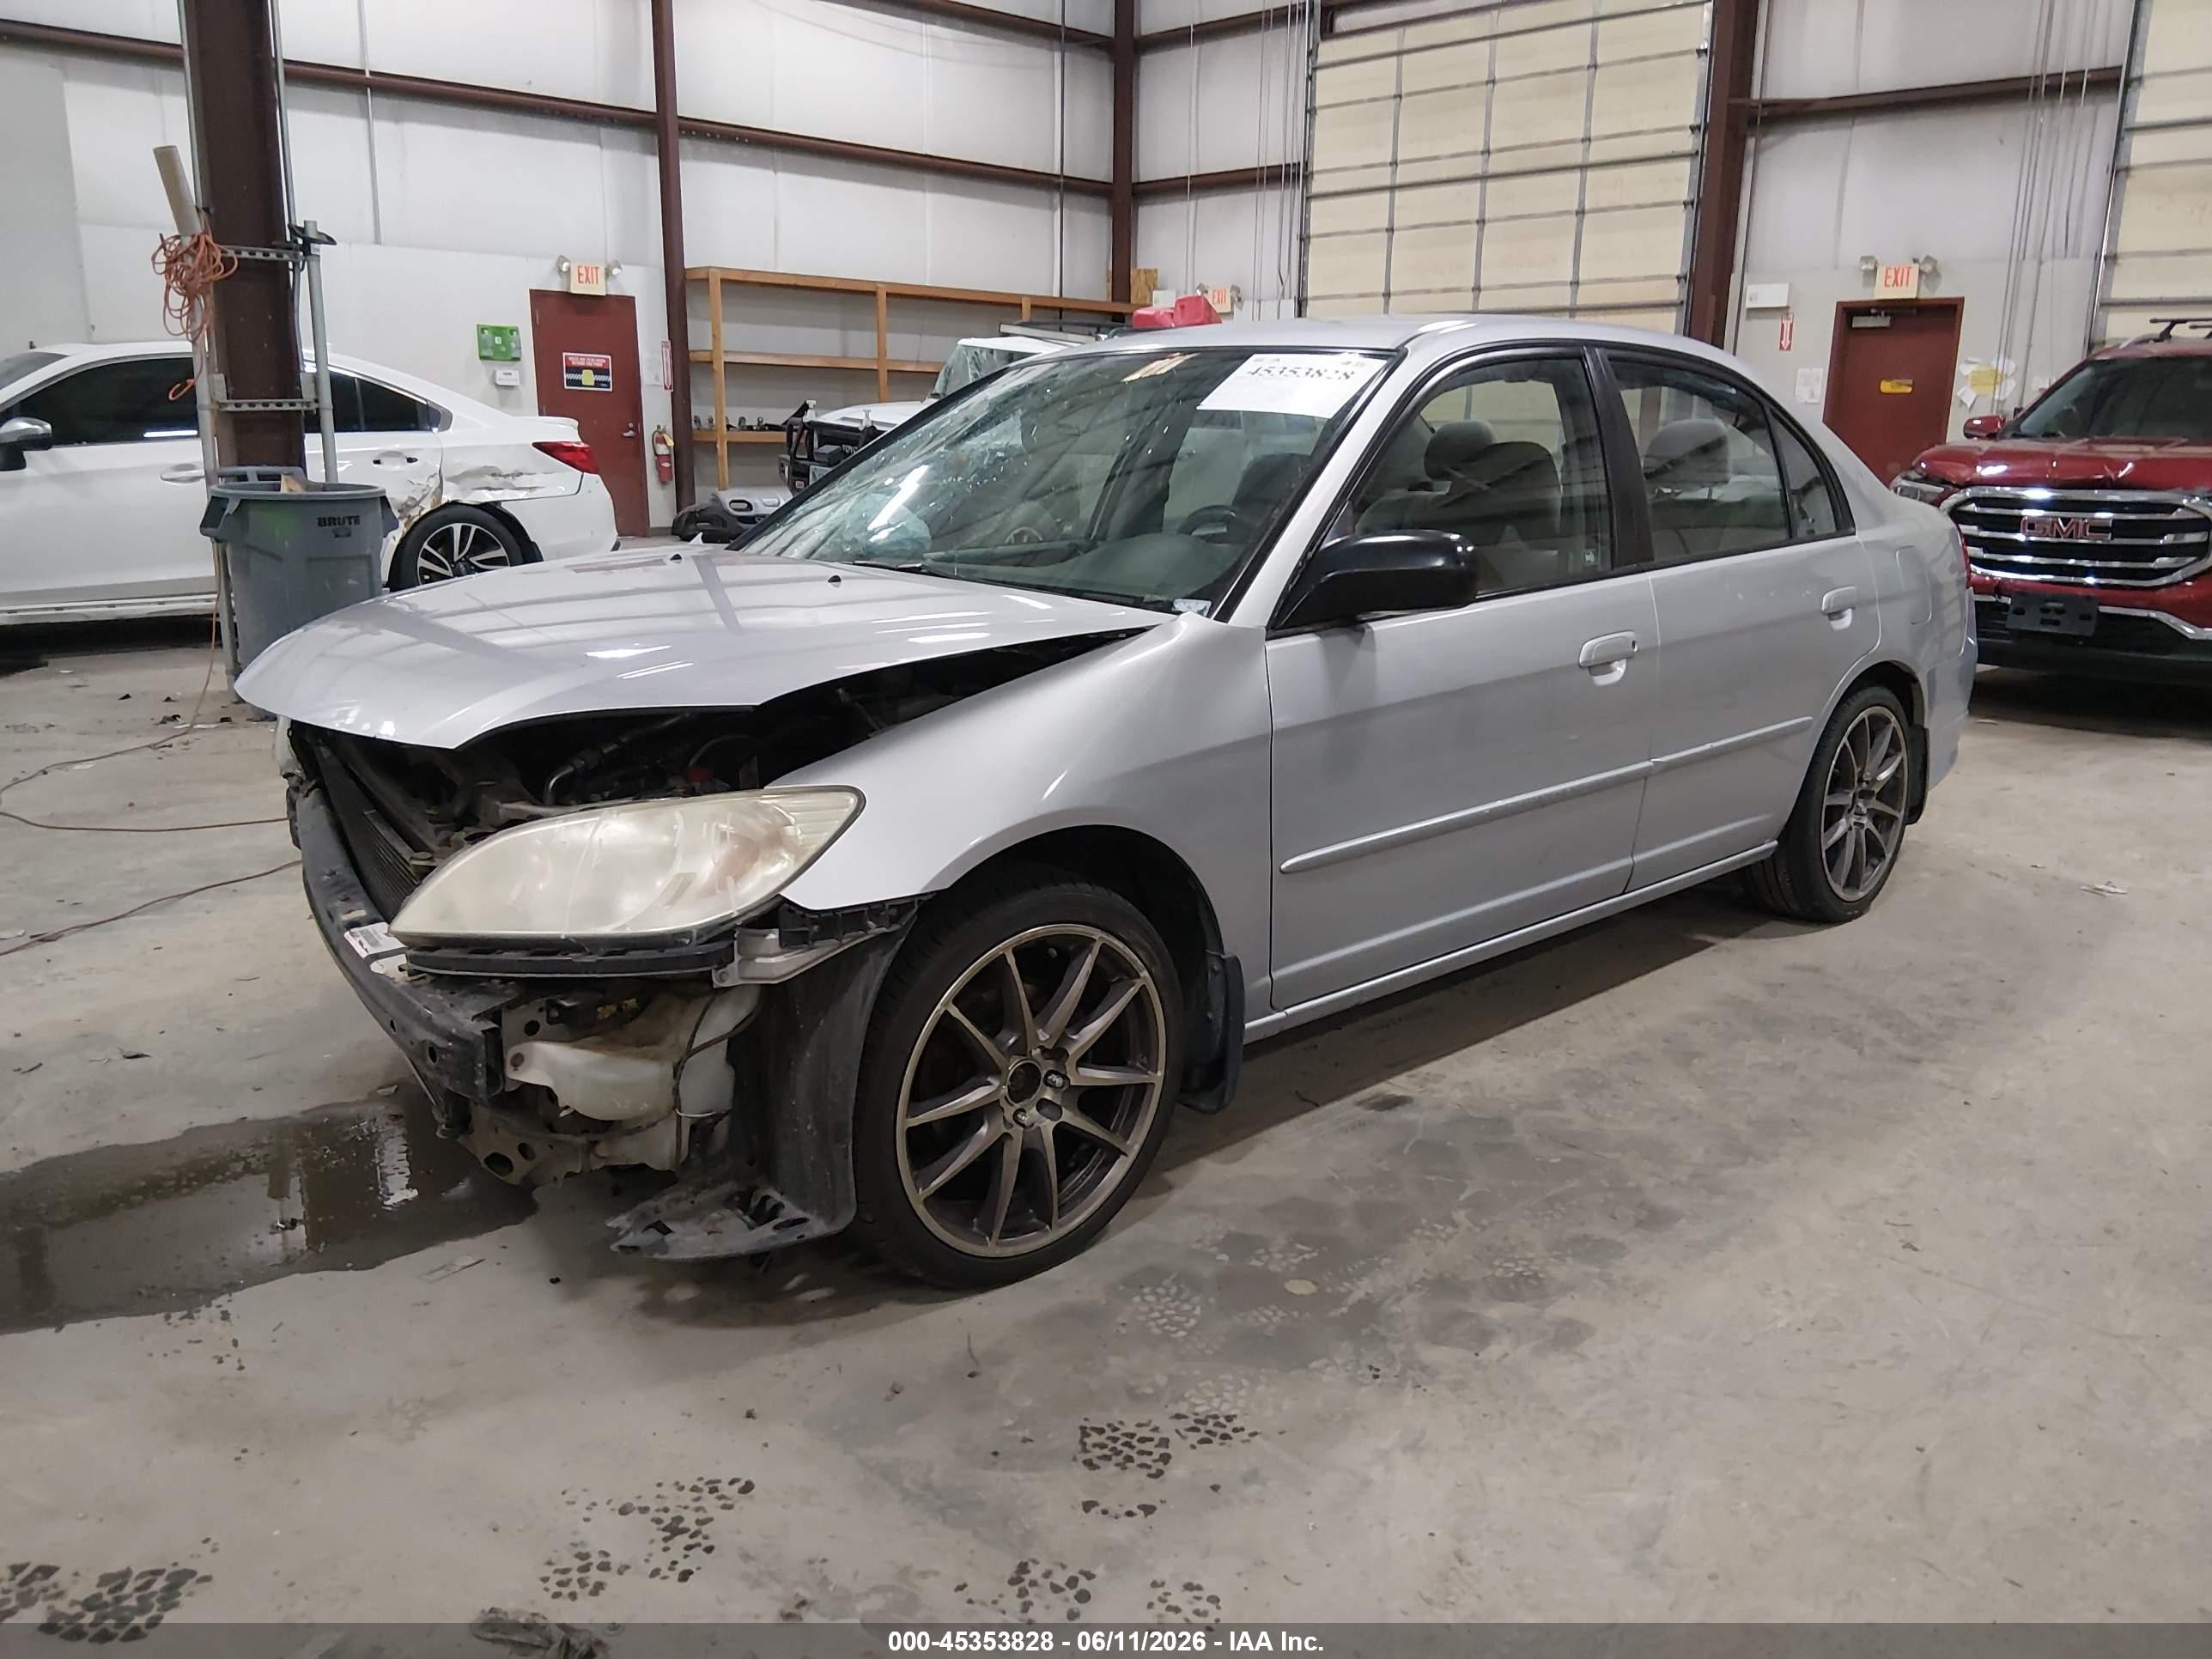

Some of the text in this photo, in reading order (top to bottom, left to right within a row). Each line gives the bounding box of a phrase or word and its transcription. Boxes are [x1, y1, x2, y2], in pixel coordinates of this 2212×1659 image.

[577, 265, 599, 284] EXIT
[1884, 265, 1911, 288] EXIT
[1212, 288, 1227, 305] EXIT
[317, 515, 361, 527] BRUTE
[2020, 514, 2112, 541] GMC
